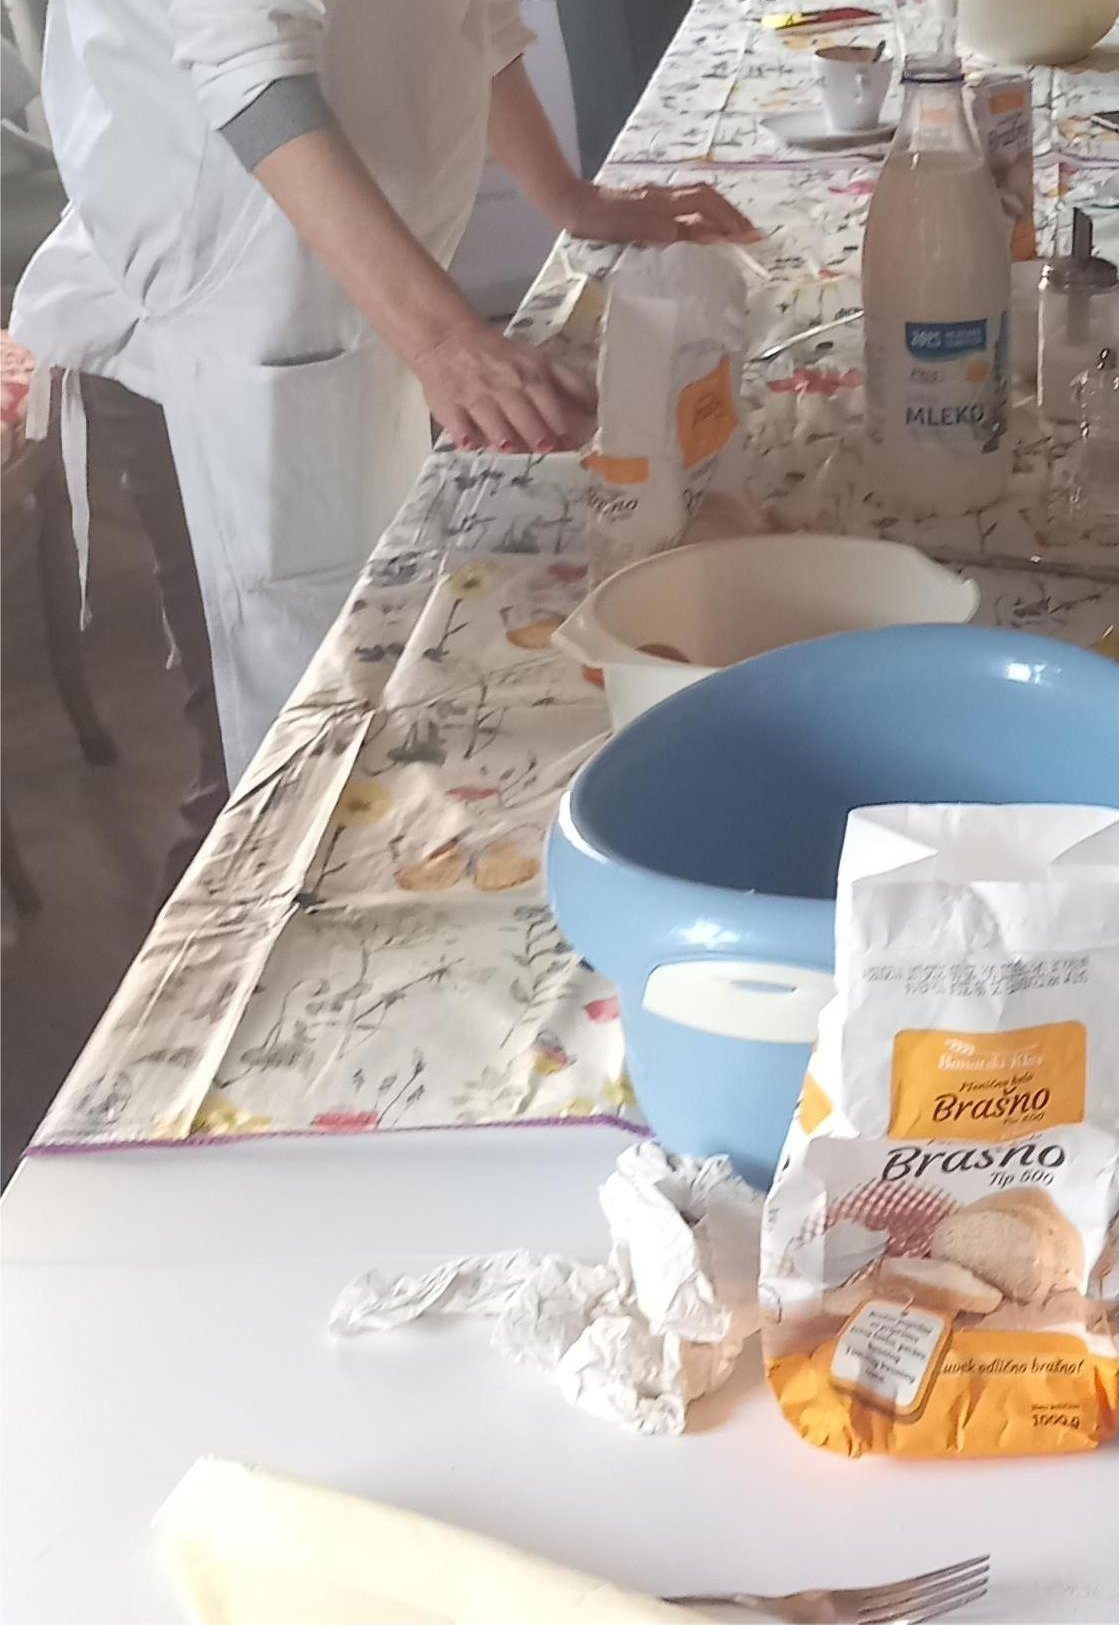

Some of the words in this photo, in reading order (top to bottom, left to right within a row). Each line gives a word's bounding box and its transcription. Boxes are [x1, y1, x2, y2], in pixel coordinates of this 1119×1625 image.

[905, 405, 984, 426] MLEKO
[932, 1086, 1050, 1123] Brašno
[989, 1170, 1016, 1188] Tip
